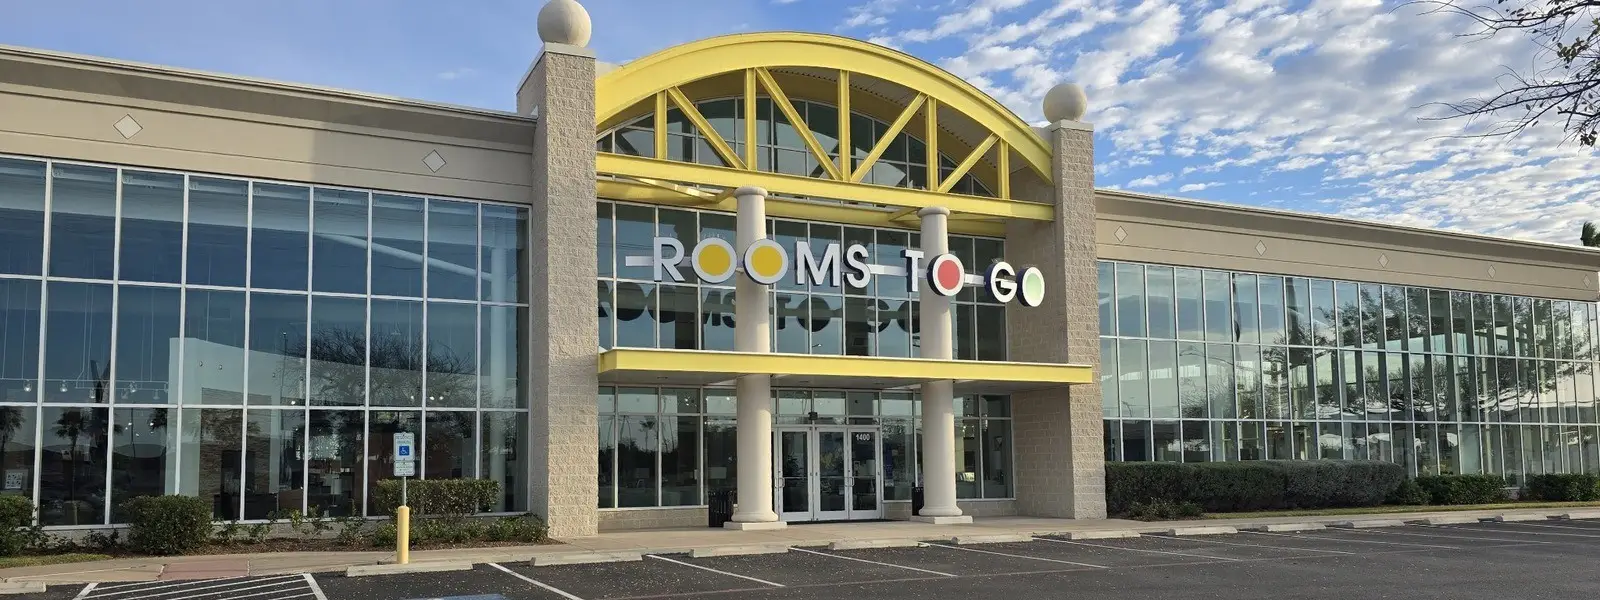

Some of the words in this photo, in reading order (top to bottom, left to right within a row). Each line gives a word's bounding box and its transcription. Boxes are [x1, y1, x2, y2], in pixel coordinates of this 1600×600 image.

[653, 236, 871, 289] ROOMS
[901, 249, 965, 297] TO
[985, 261, 1045, 308] GO
[855, 433, 871, 441] 1400
